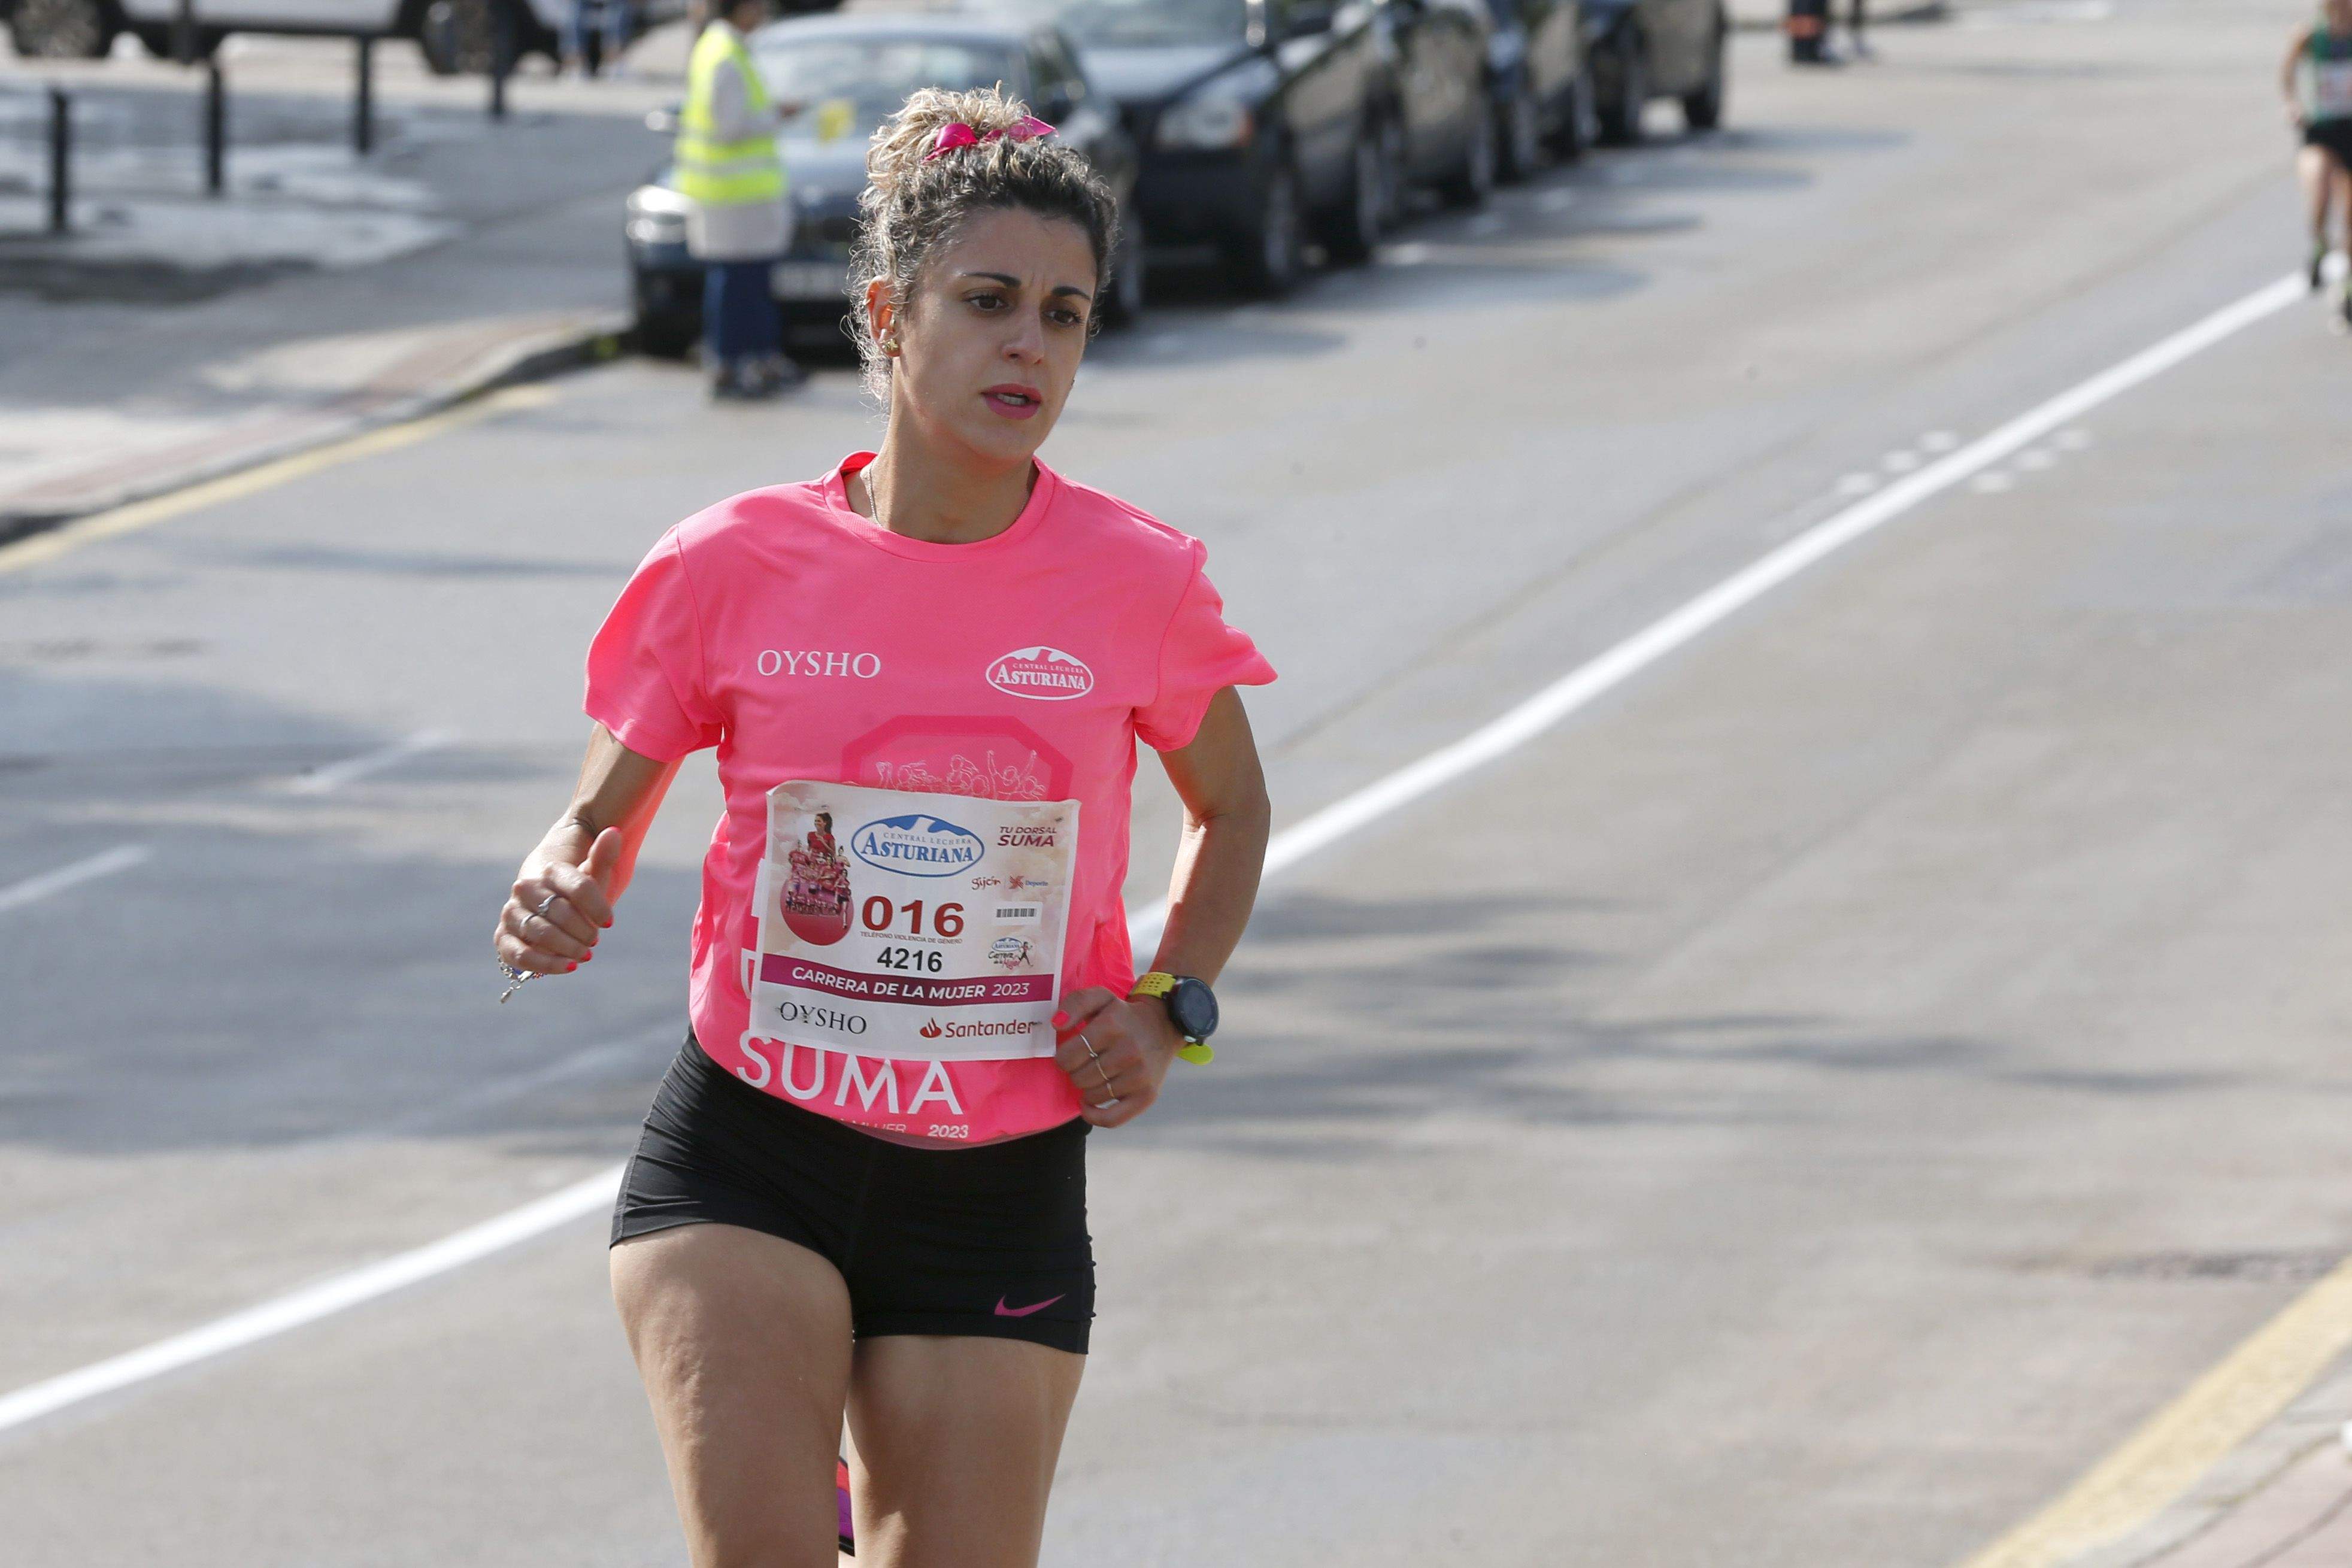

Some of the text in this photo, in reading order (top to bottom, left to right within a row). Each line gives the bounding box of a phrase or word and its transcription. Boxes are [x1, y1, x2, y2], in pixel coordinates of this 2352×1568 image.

[757, 649, 881, 678] OYSHO
[995, 664, 1087, 690] ASTURIANA
[861, 832, 974, 863] ASTURIANA
[883, 832, 926, 843] CENTRAL
[997, 835, 1054, 847] SUMA
[862, 895, 965, 938] 016
[894, 934, 926, 942] VIOLENCIA
[877, 947, 942, 972] 4216
[792, 966, 1030, 999] CARRERA DE LA MUJER 2023
[780, 1002, 867, 1035] OYSHO
[945, 1019, 1034, 1038] Santander
[736, 1029, 964, 1115] SUMA
[928, 1124, 969, 1139] 2023
